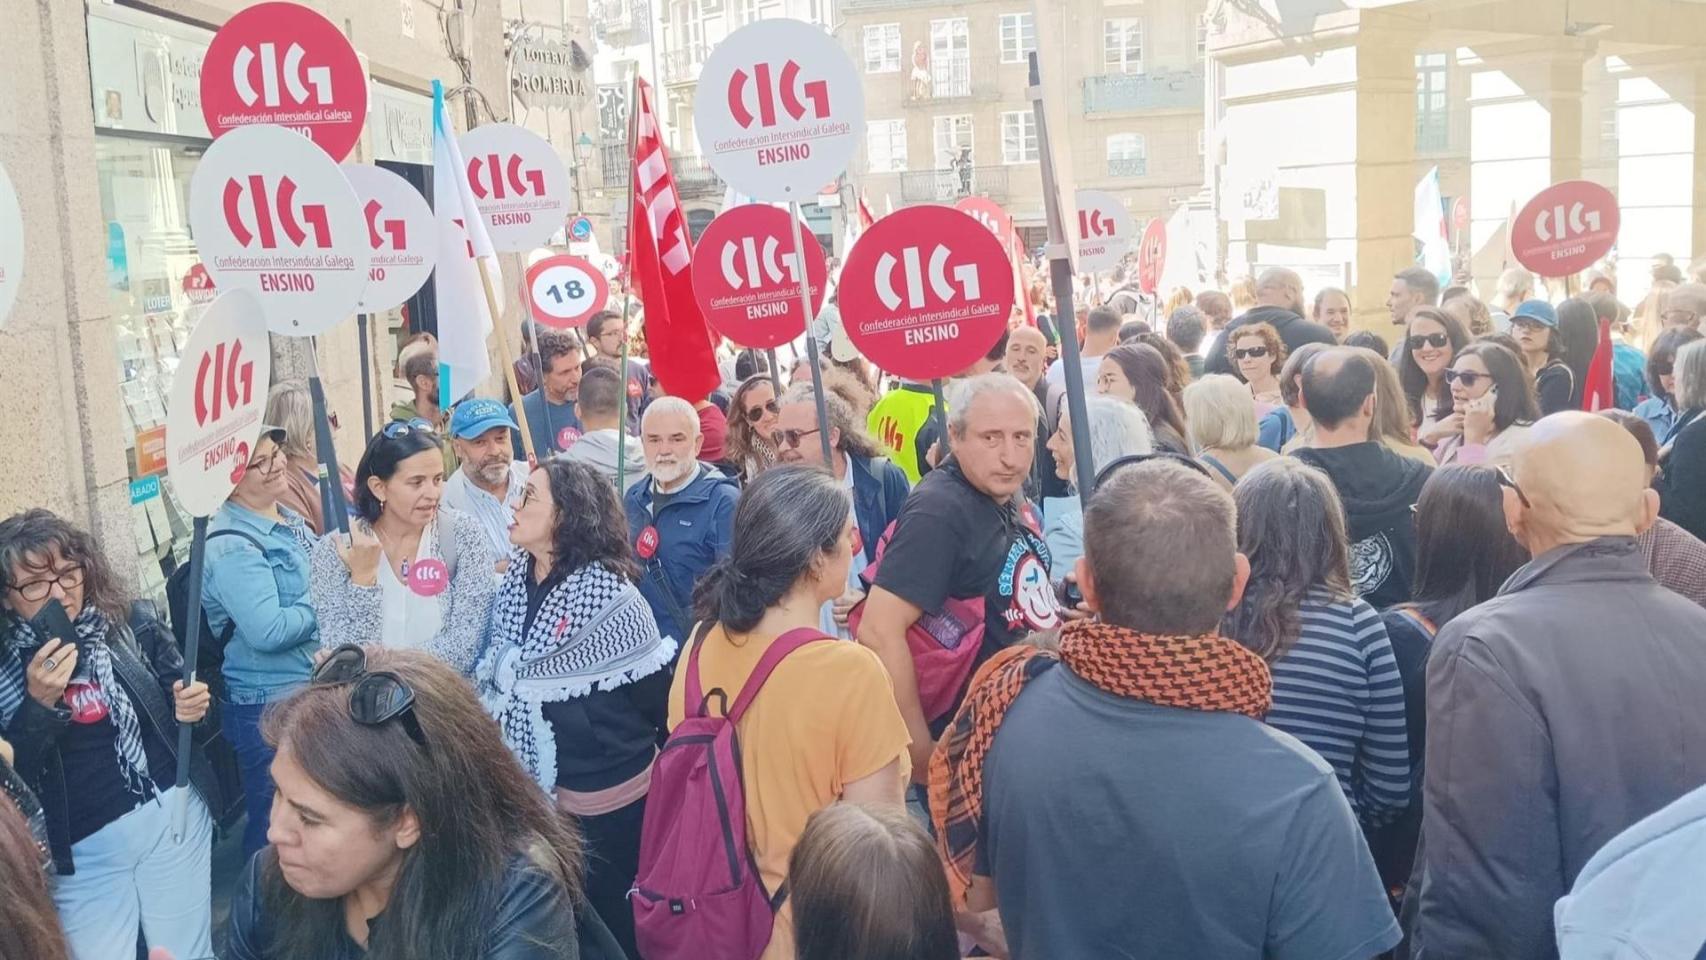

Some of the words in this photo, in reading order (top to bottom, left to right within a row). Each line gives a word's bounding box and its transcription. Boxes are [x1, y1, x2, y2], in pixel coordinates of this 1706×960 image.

[233, 42, 333, 107] CIG
[728, 59, 831, 129] CIG
[217, 112, 273, 125] Confederación
[274, 109, 322, 123] Intersindical
[323, 108, 352, 121] Galega
[770, 125, 820, 144] Intersindical
[821, 121, 850, 135] Galega
[757, 143, 810, 166] ENSINO
[467, 153, 546, 199] CIG
[223, 175, 332, 248] CIG
[491, 212, 531, 226] ENSINO
[1078, 208, 1115, 239] IG
[1535, 201, 1600, 242] CIG
[272, 254, 323, 268] Intersindical
[324, 255, 355, 270] Galega
[720, 235, 801, 290] CIG
[875, 243, 980, 311] CIG
[260, 273, 314, 292] ENSINO
[546, 280, 585, 304] 18
[747, 301, 788, 320] ENSINO
[859, 315, 917, 333] Confederación
[919, 306, 970, 323] Intersindical
[971, 303, 1000, 317] Galega
[905, 323, 959, 345] ENSINO
[195, 338, 253, 428] CIG
[204, 437, 236, 472] ENSINO
[416, 566, 440, 580] CIG
